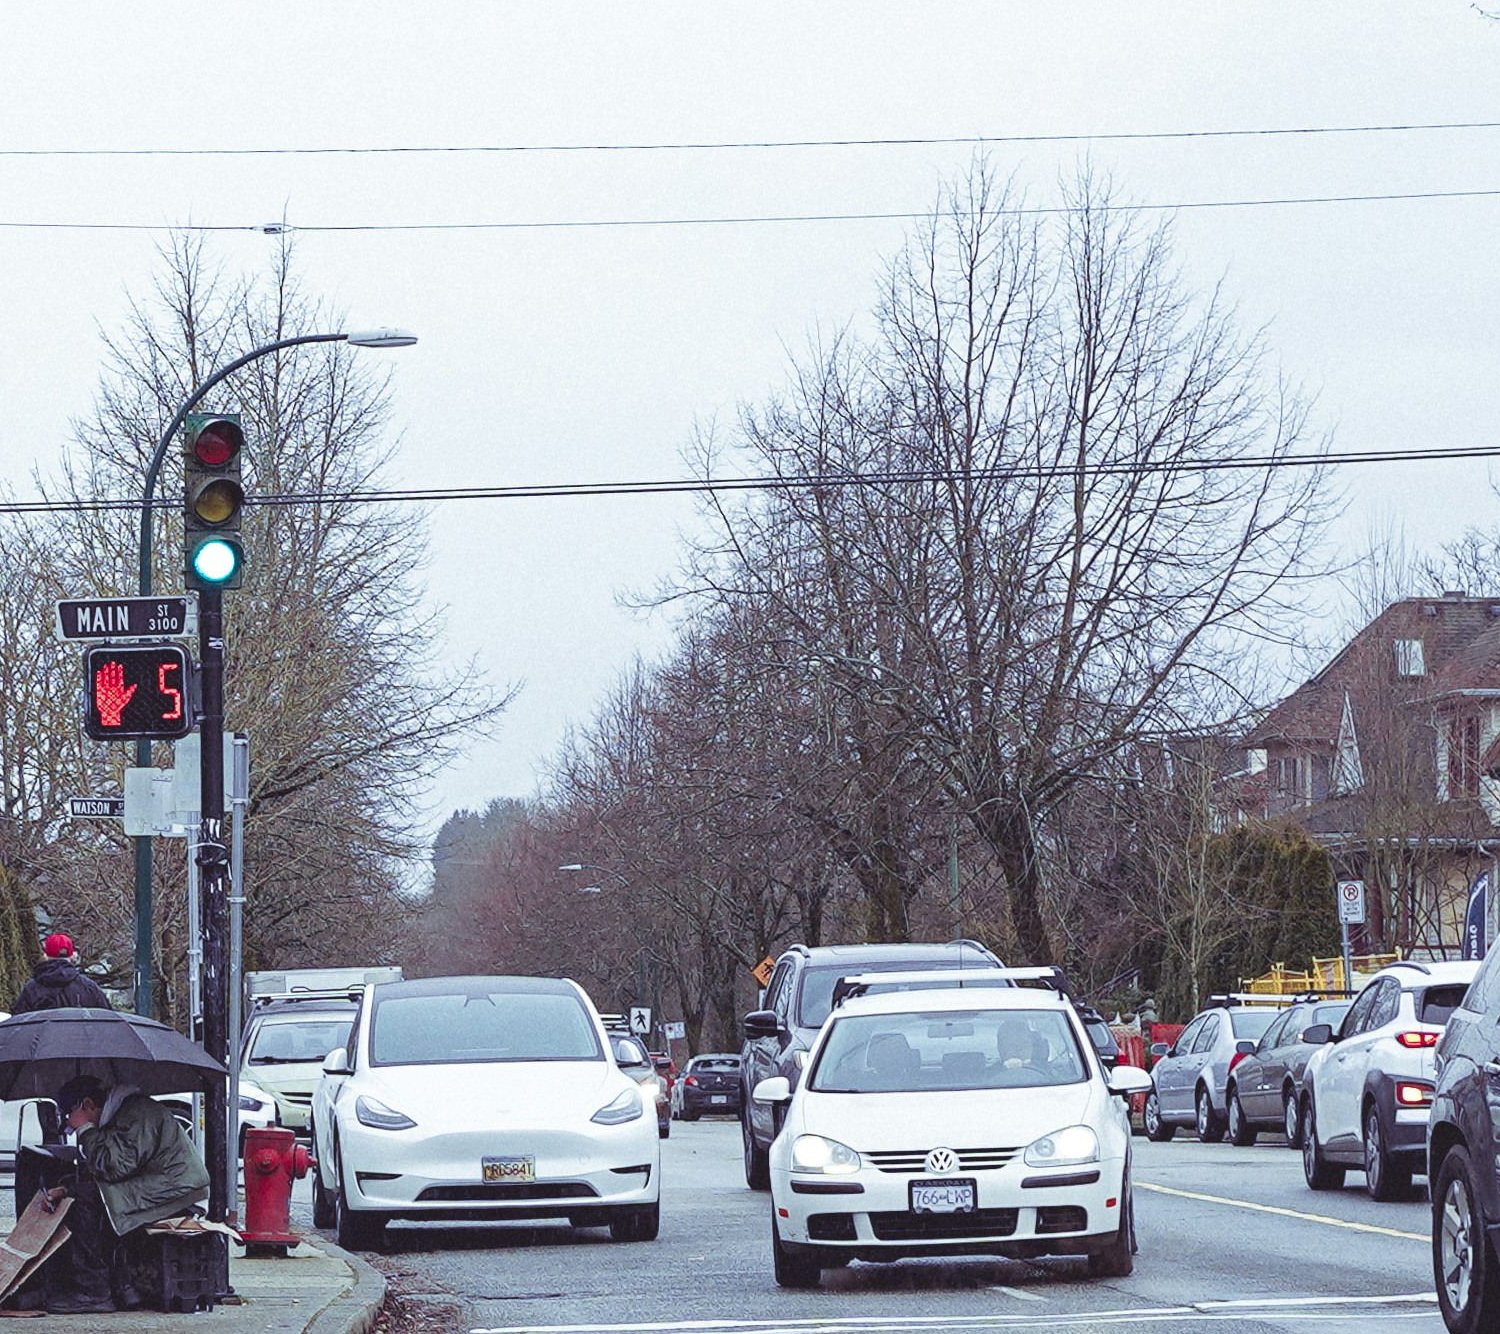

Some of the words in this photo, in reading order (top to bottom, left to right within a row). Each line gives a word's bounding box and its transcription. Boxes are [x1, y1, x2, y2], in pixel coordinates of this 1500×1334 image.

[77, 605, 129, 633] MAIN
[157, 604, 169, 617] ST
[149, 617, 179, 631] 3100
[158, 662, 181, 720] 5
[73, 800, 110, 815] WATSON
[914, 1190, 939, 1205] 766
